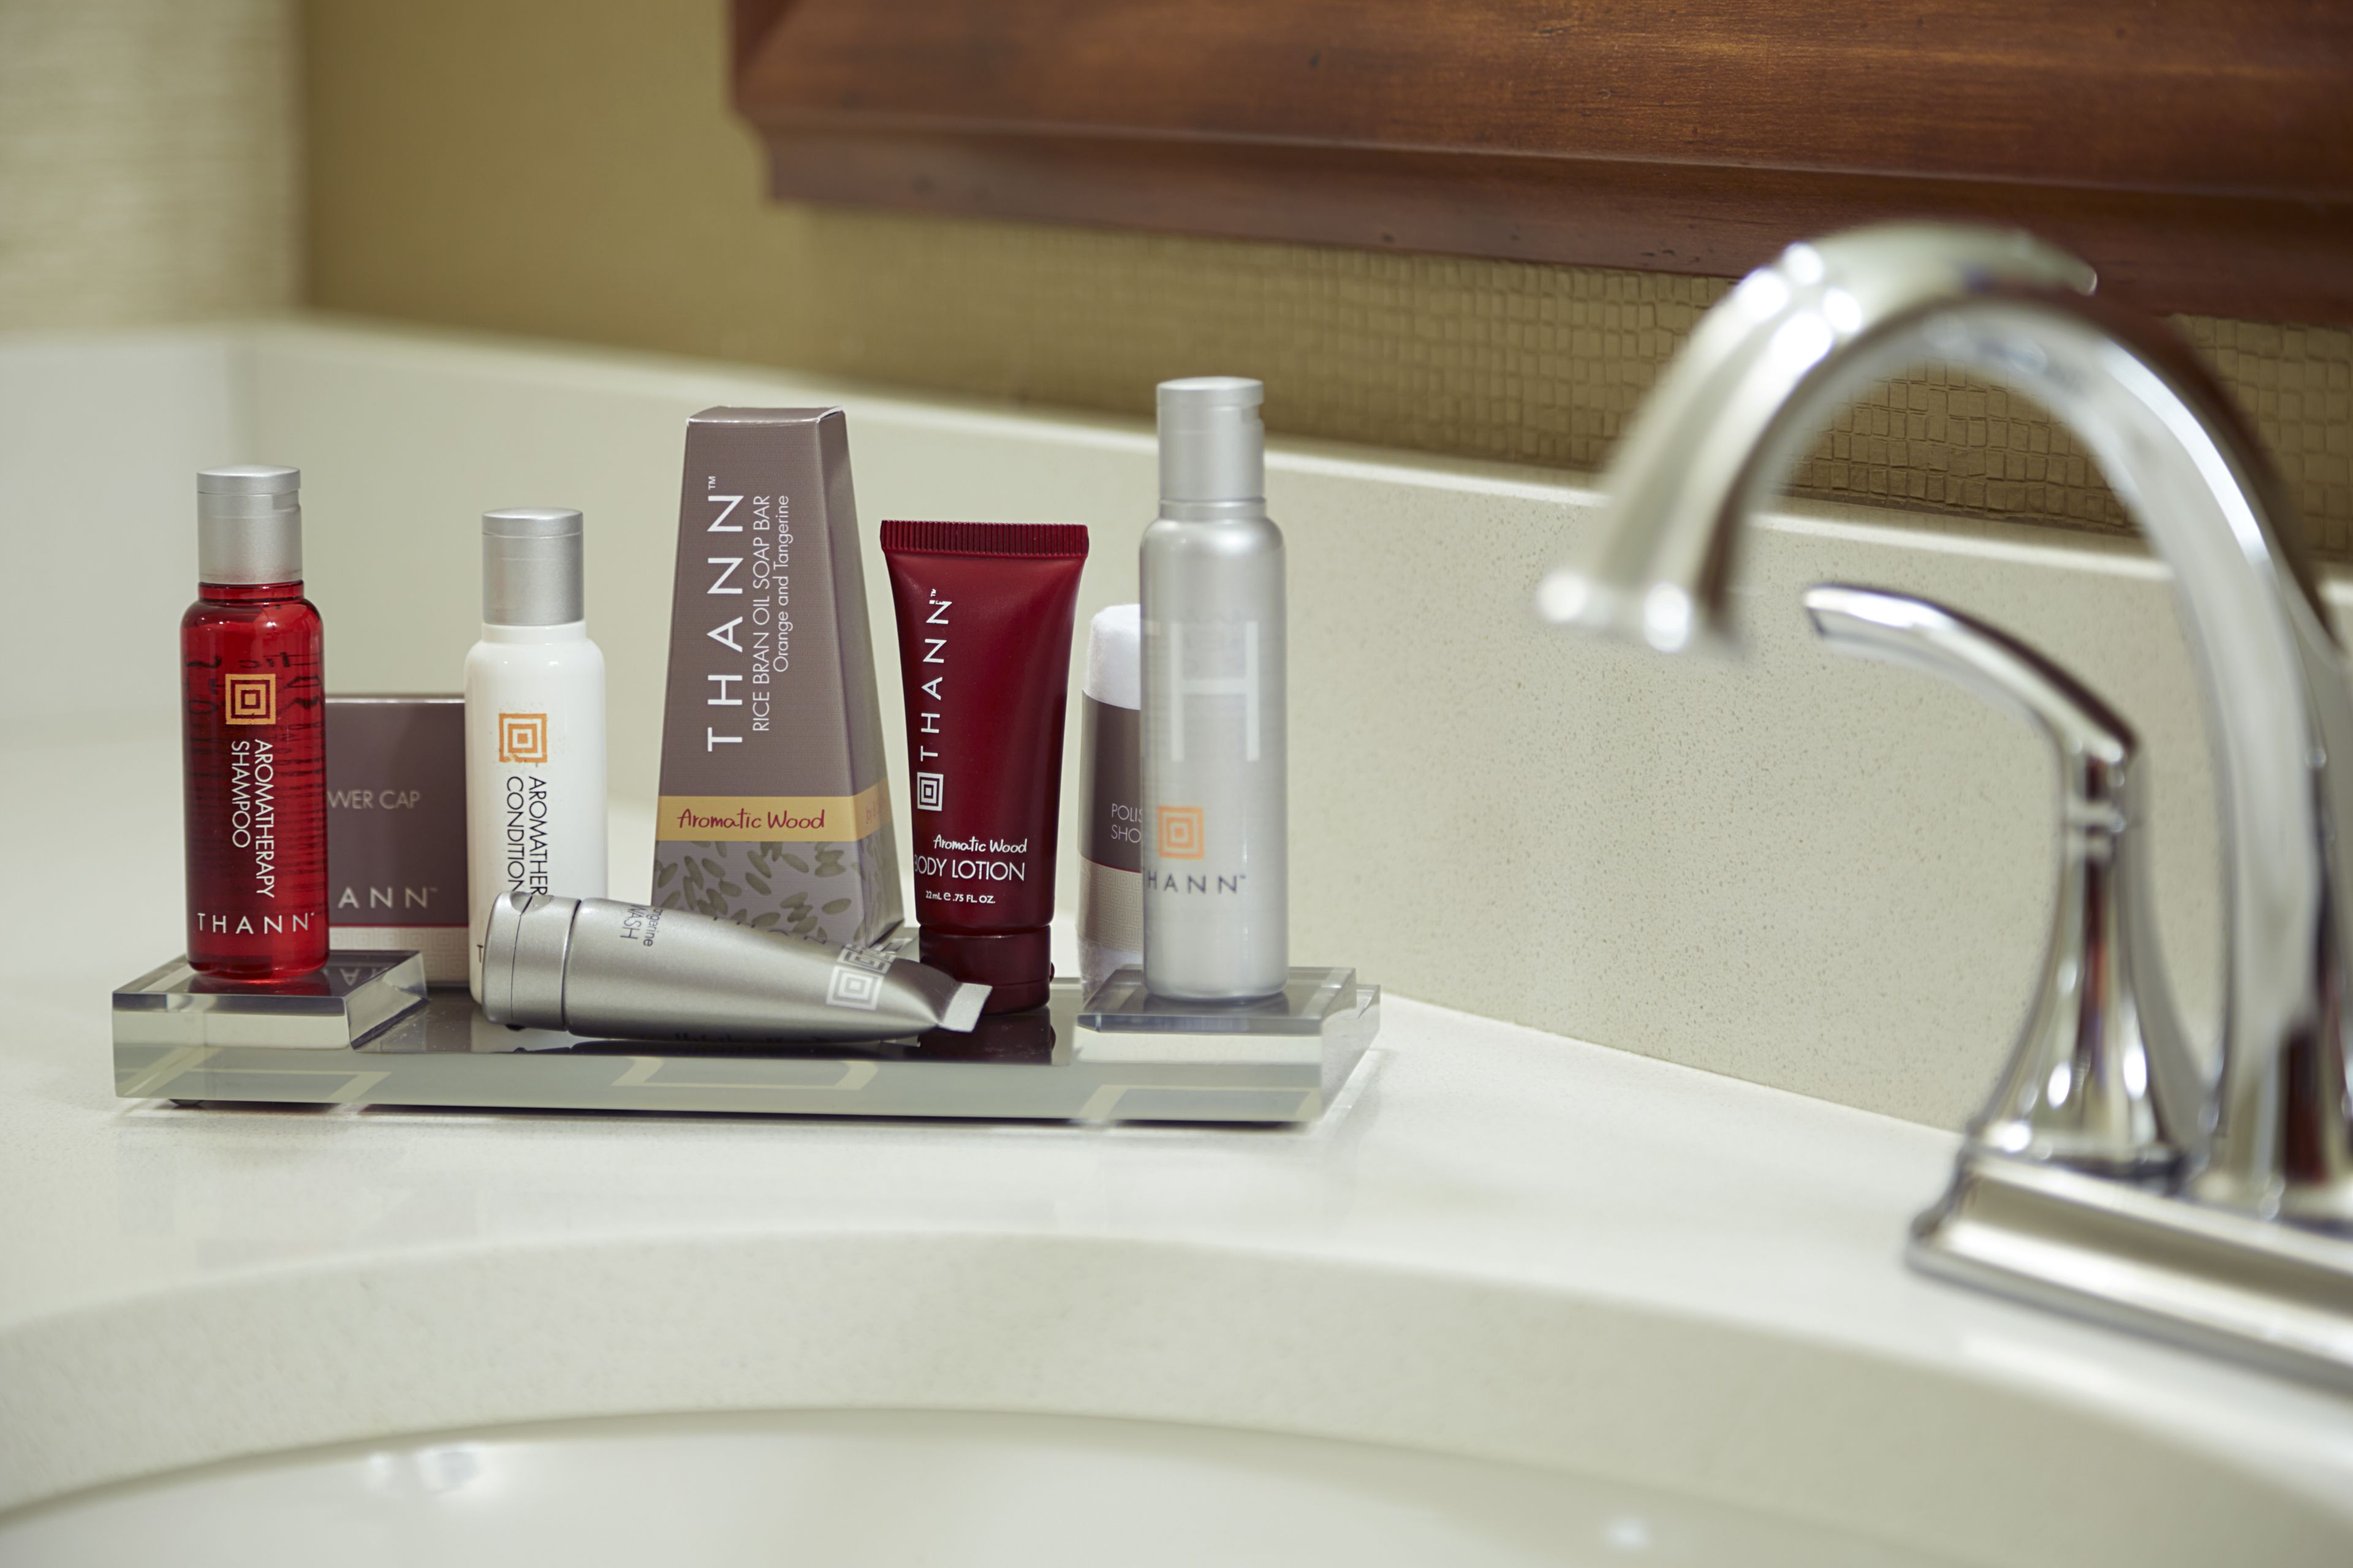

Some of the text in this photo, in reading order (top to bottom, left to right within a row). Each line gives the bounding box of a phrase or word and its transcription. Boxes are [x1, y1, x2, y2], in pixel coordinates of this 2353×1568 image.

[772, 496, 794, 672] Orange and Tangerine
[753, 496, 770, 731] RICE BRAN OIL SOAP BAR
[231, 741, 251, 848] SHAMPOO
[327, 789, 422, 810] WER CAP
[254, 739, 275, 898] AROMATHERAPY
[677, 808, 825, 829] Aromatic Wood
[1111, 803, 1143, 823] POLIS
[507, 776, 525, 892] CONDITION
[529, 776, 548, 895] AROMATHER
[933, 834, 1028, 854] Aromatic Wood
[1111, 824, 1142, 844] SHO
[952, 859, 1025, 881] LOTION
[925, 890, 942, 901] 22mL
[952, 893, 964, 903] .75
